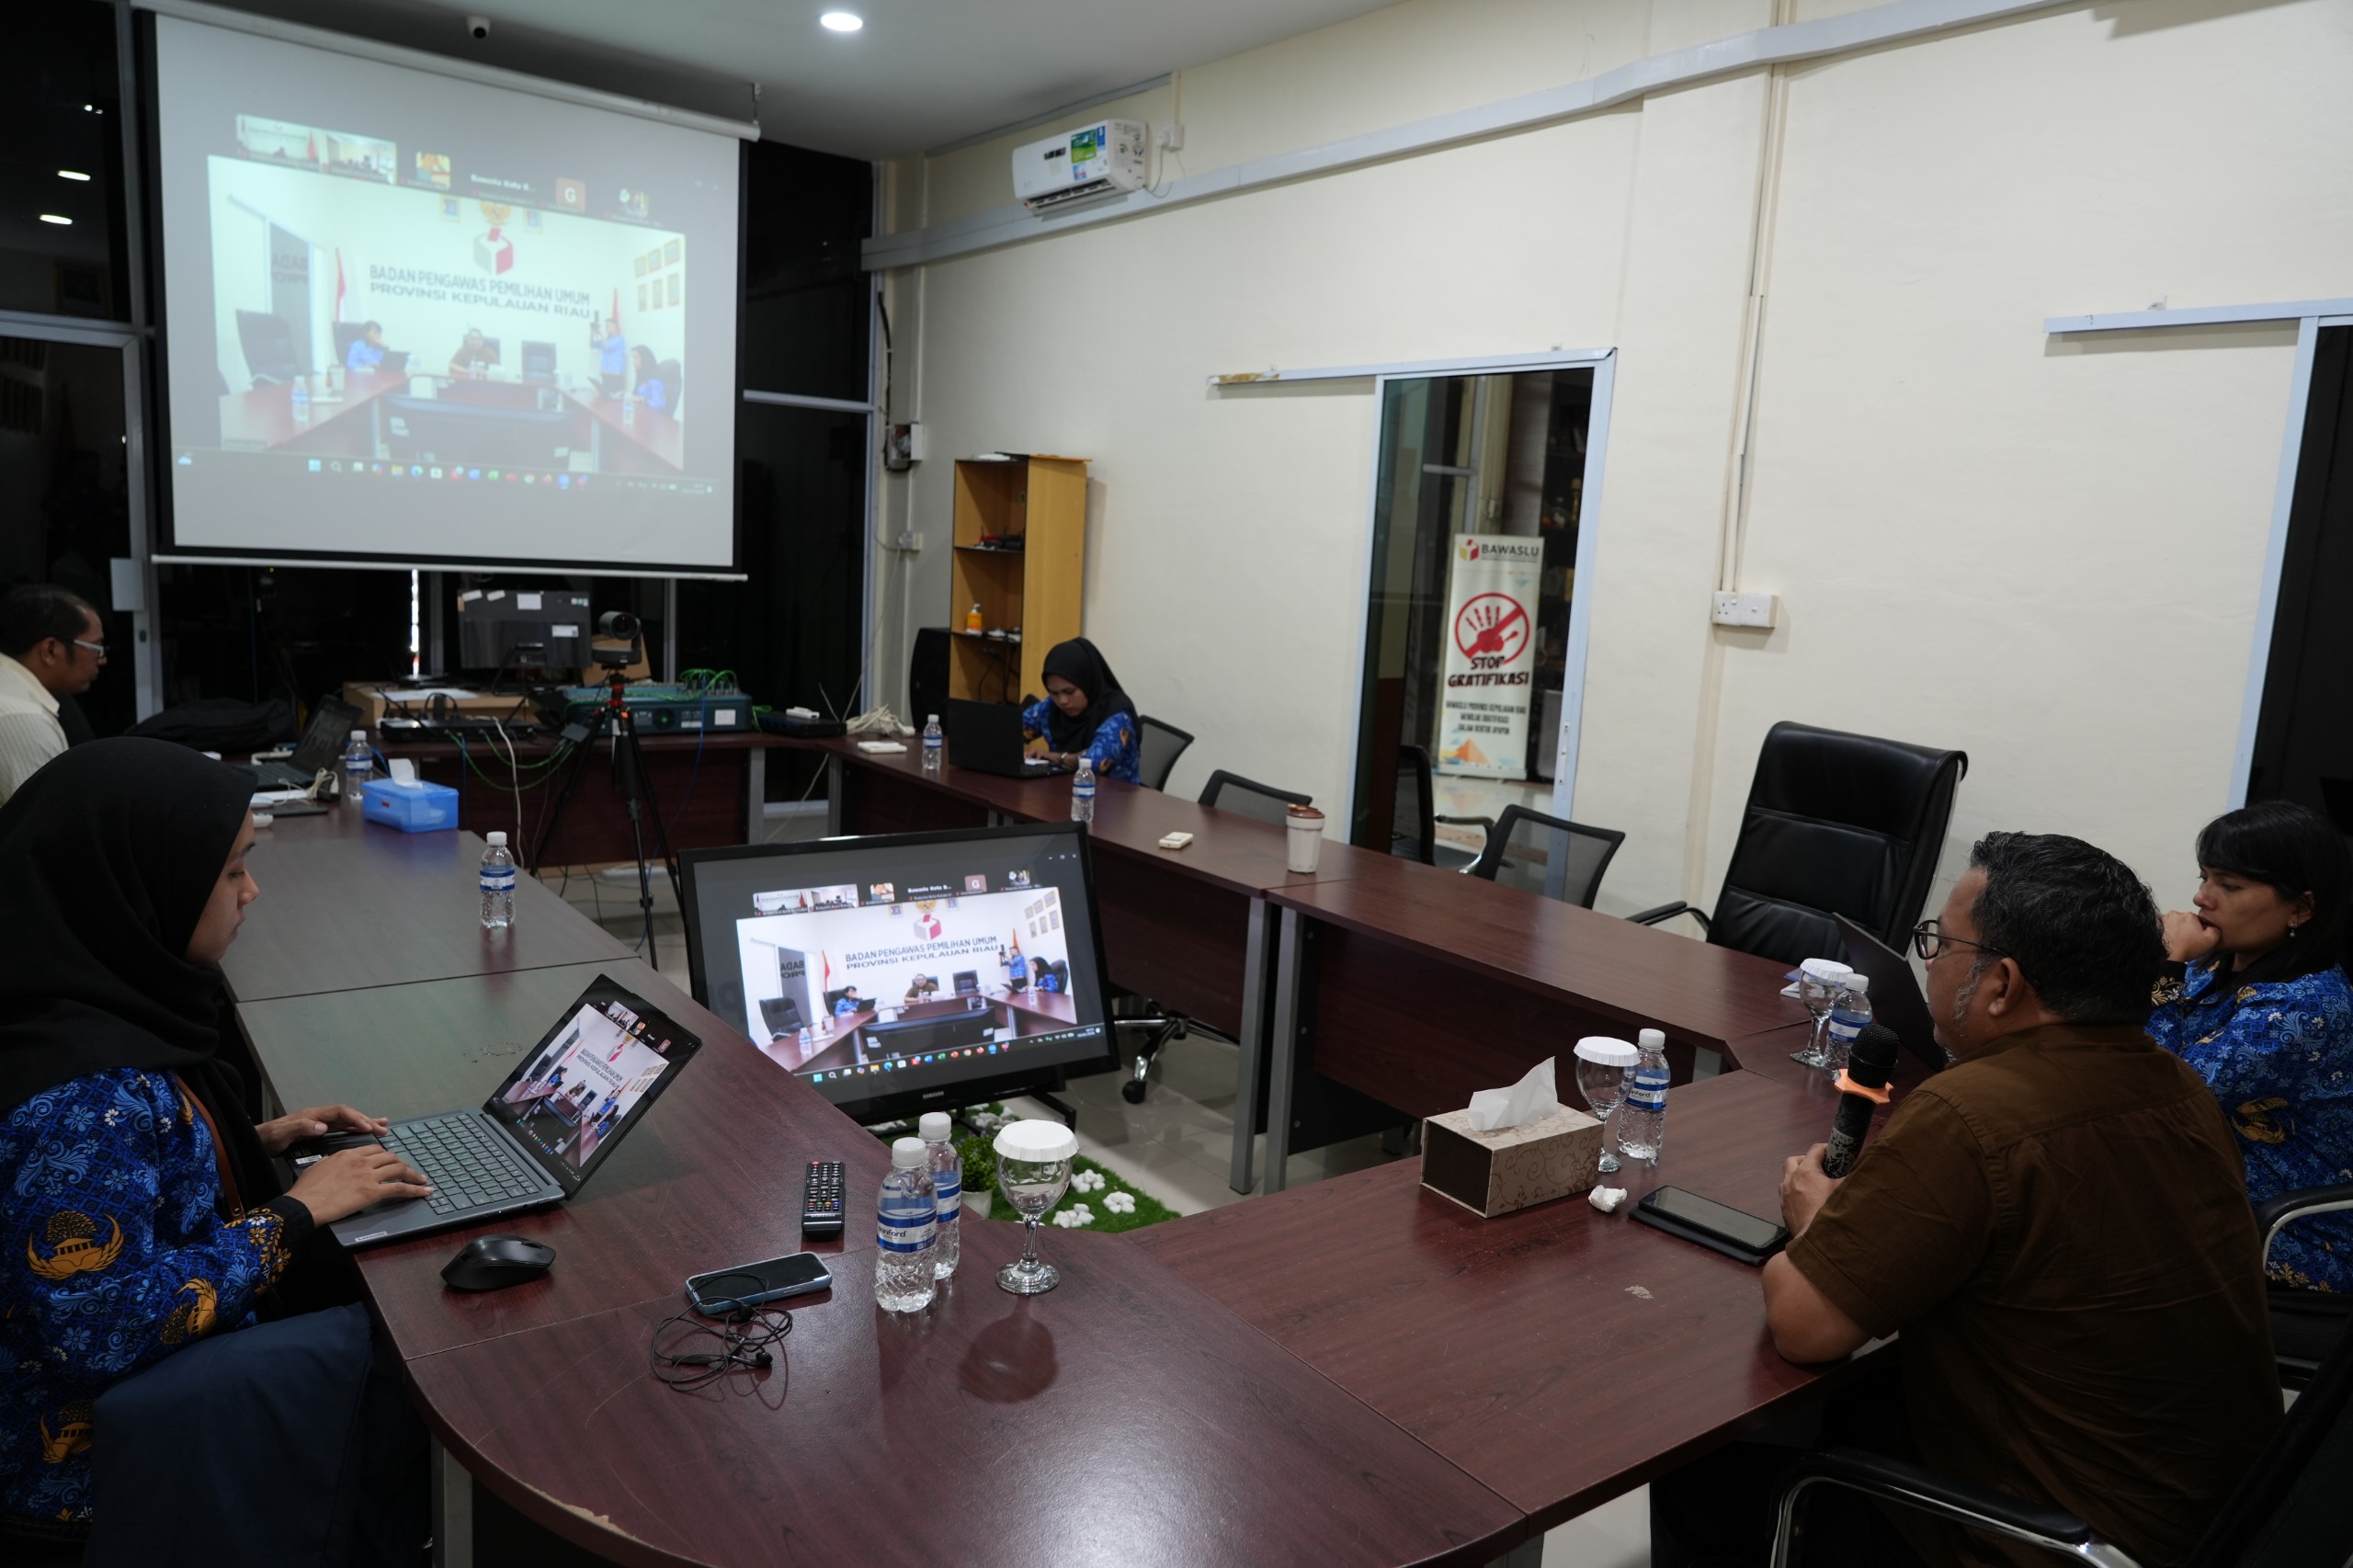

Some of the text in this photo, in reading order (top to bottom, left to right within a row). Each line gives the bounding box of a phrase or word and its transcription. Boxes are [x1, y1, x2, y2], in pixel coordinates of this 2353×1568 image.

[564, 187, 576, 203] G
[369, 264, 590, 306] BADAN PENGAWAS PEMILIHAN UMUM
[370, 282, 590, 319] PROVINSI KEPULAUAN RIAU
[1482, 543, 1540, 557] BAWASLU
[1471, 655, 1505, 670] STOP
[1448, 672, 1529, 687] GRATIFIKASI
[972, 880, 980, 889] G
[846, 935, 997, 962] BADAN PENGAWAS PEMILIHAN UMUM
[847, 944, 998, 970] PROVINSI KEPULAUAN RIAU
